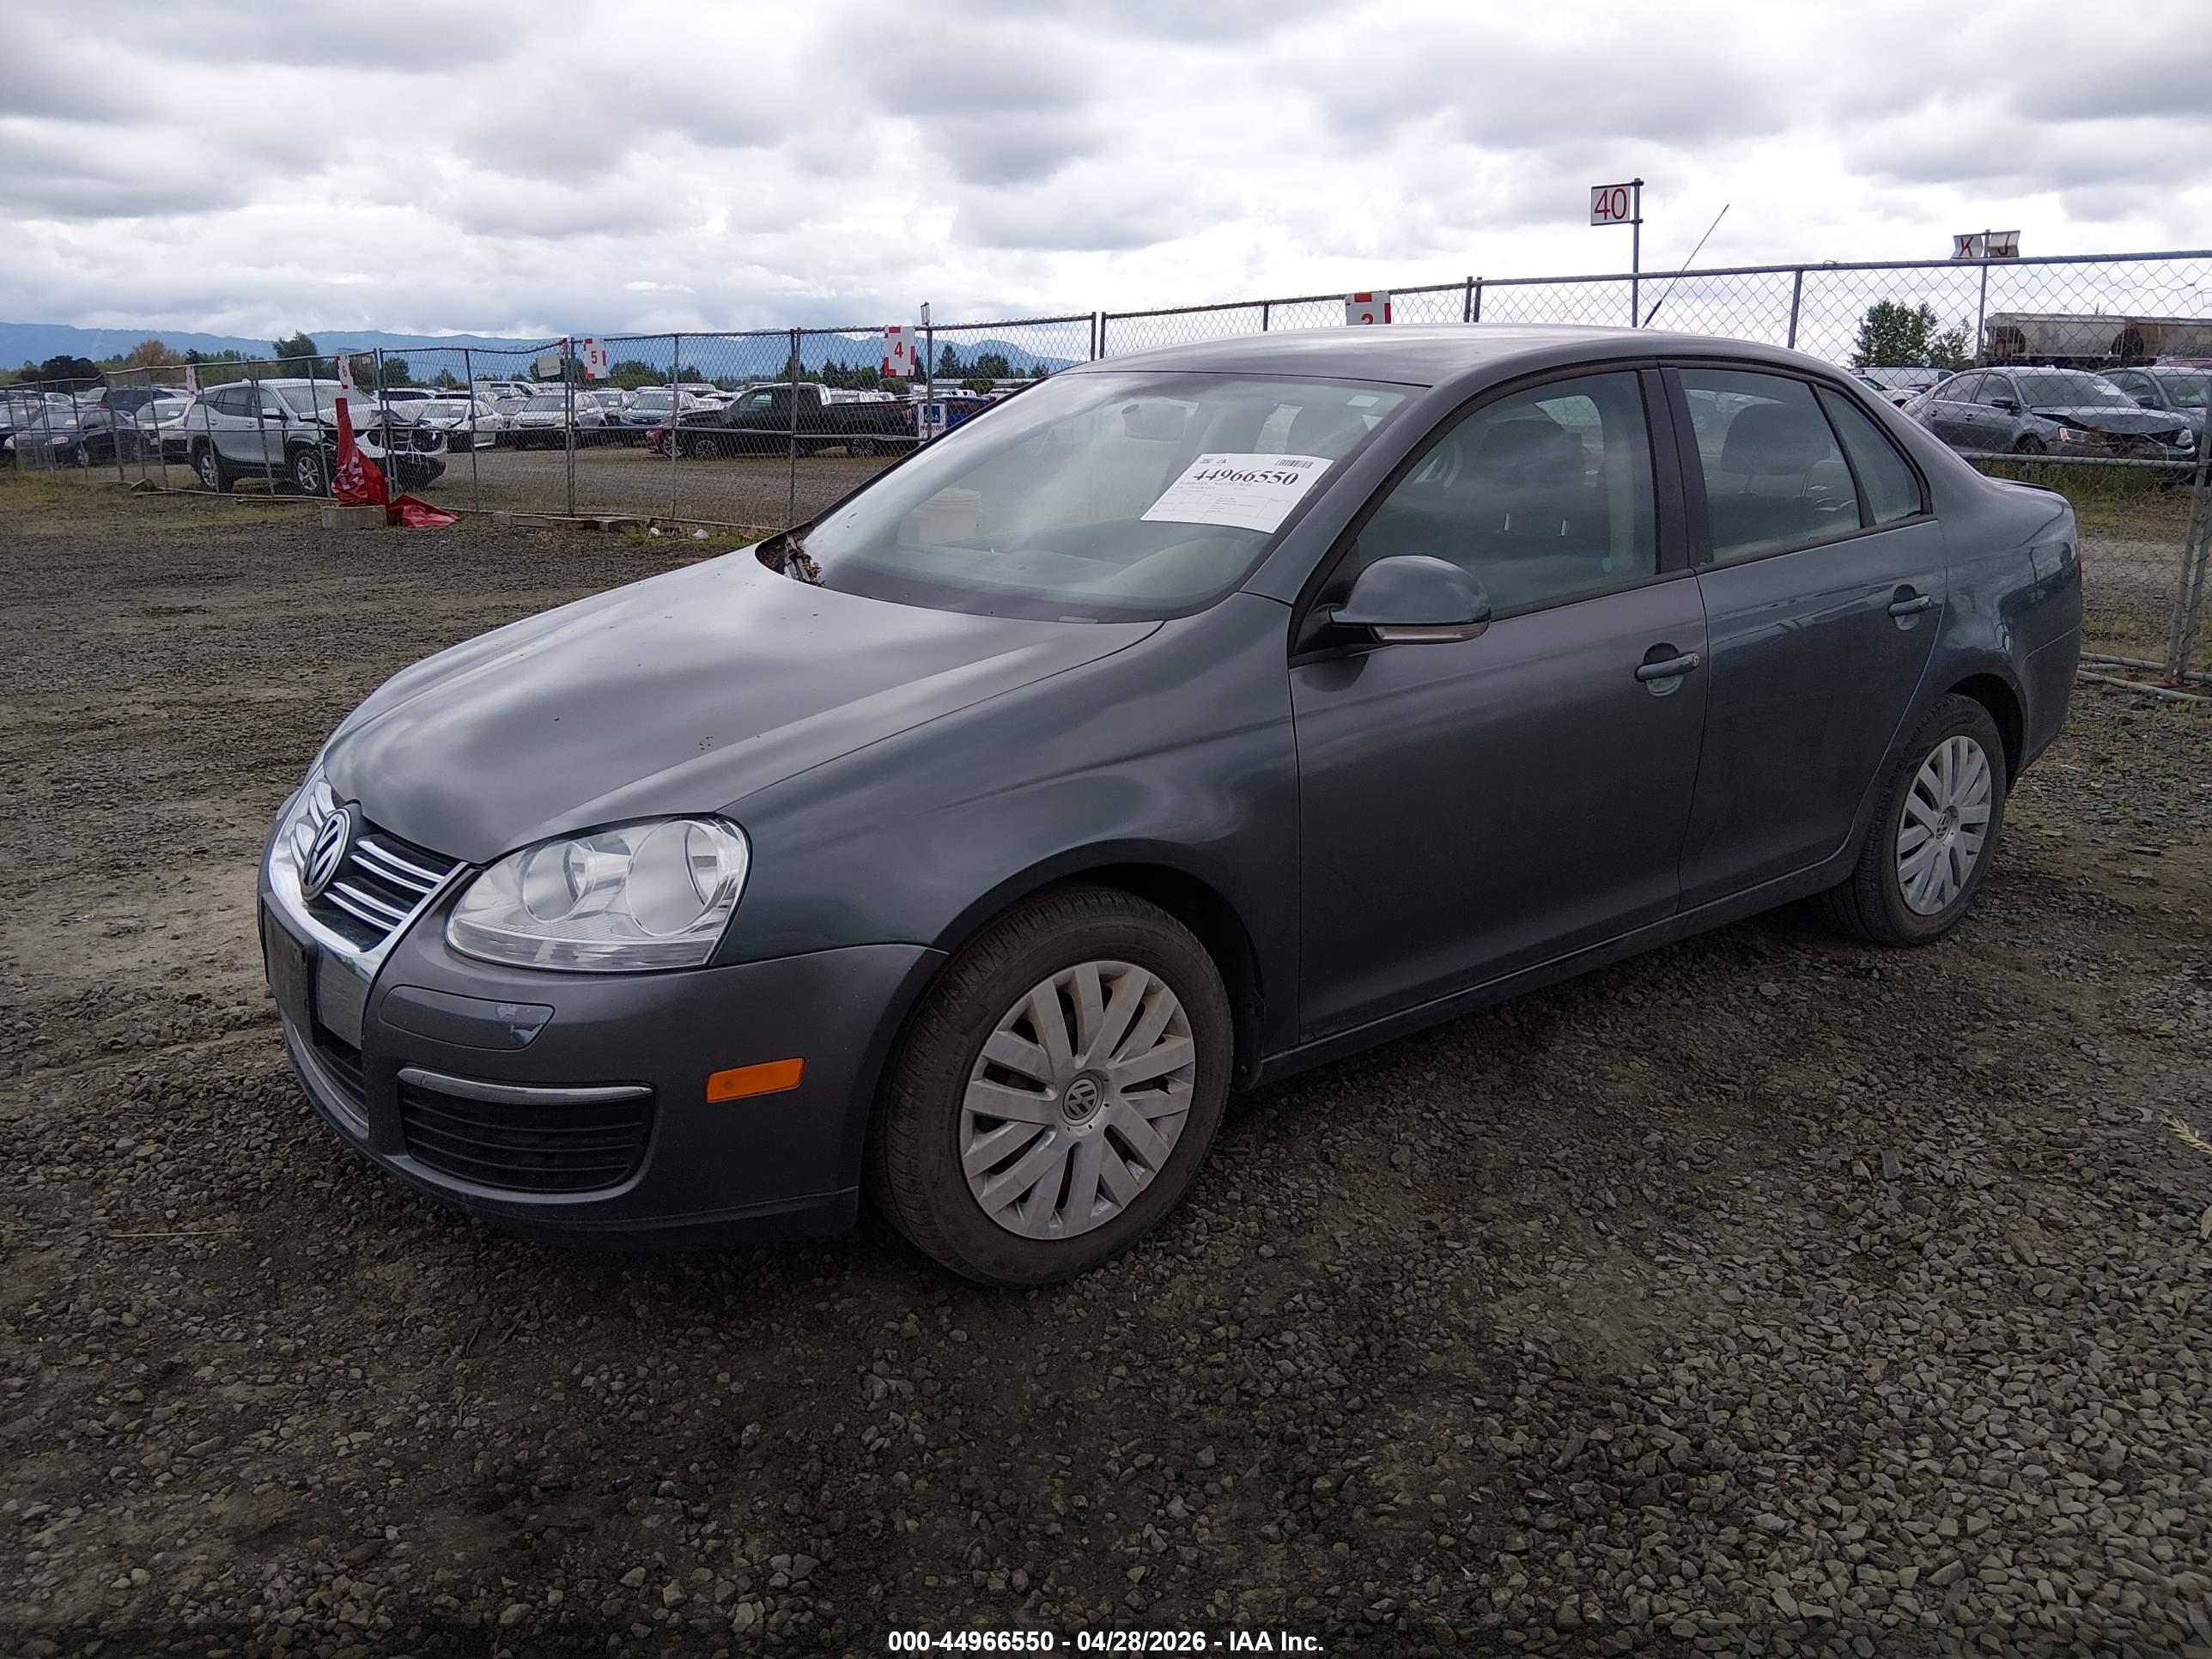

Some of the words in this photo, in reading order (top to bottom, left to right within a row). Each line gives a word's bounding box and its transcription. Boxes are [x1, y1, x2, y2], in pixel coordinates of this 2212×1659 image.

[1594, 188, 1627, 221] 40
[1959, 236, 1974, 257] K
[1997, 233, 2011, 256] J
[591, 350, 598, 365] 5
[894, 341, 904, 358] 4
[342, 365, 348, 378] 6
[1193, 468, 1299, 486] 44966550
